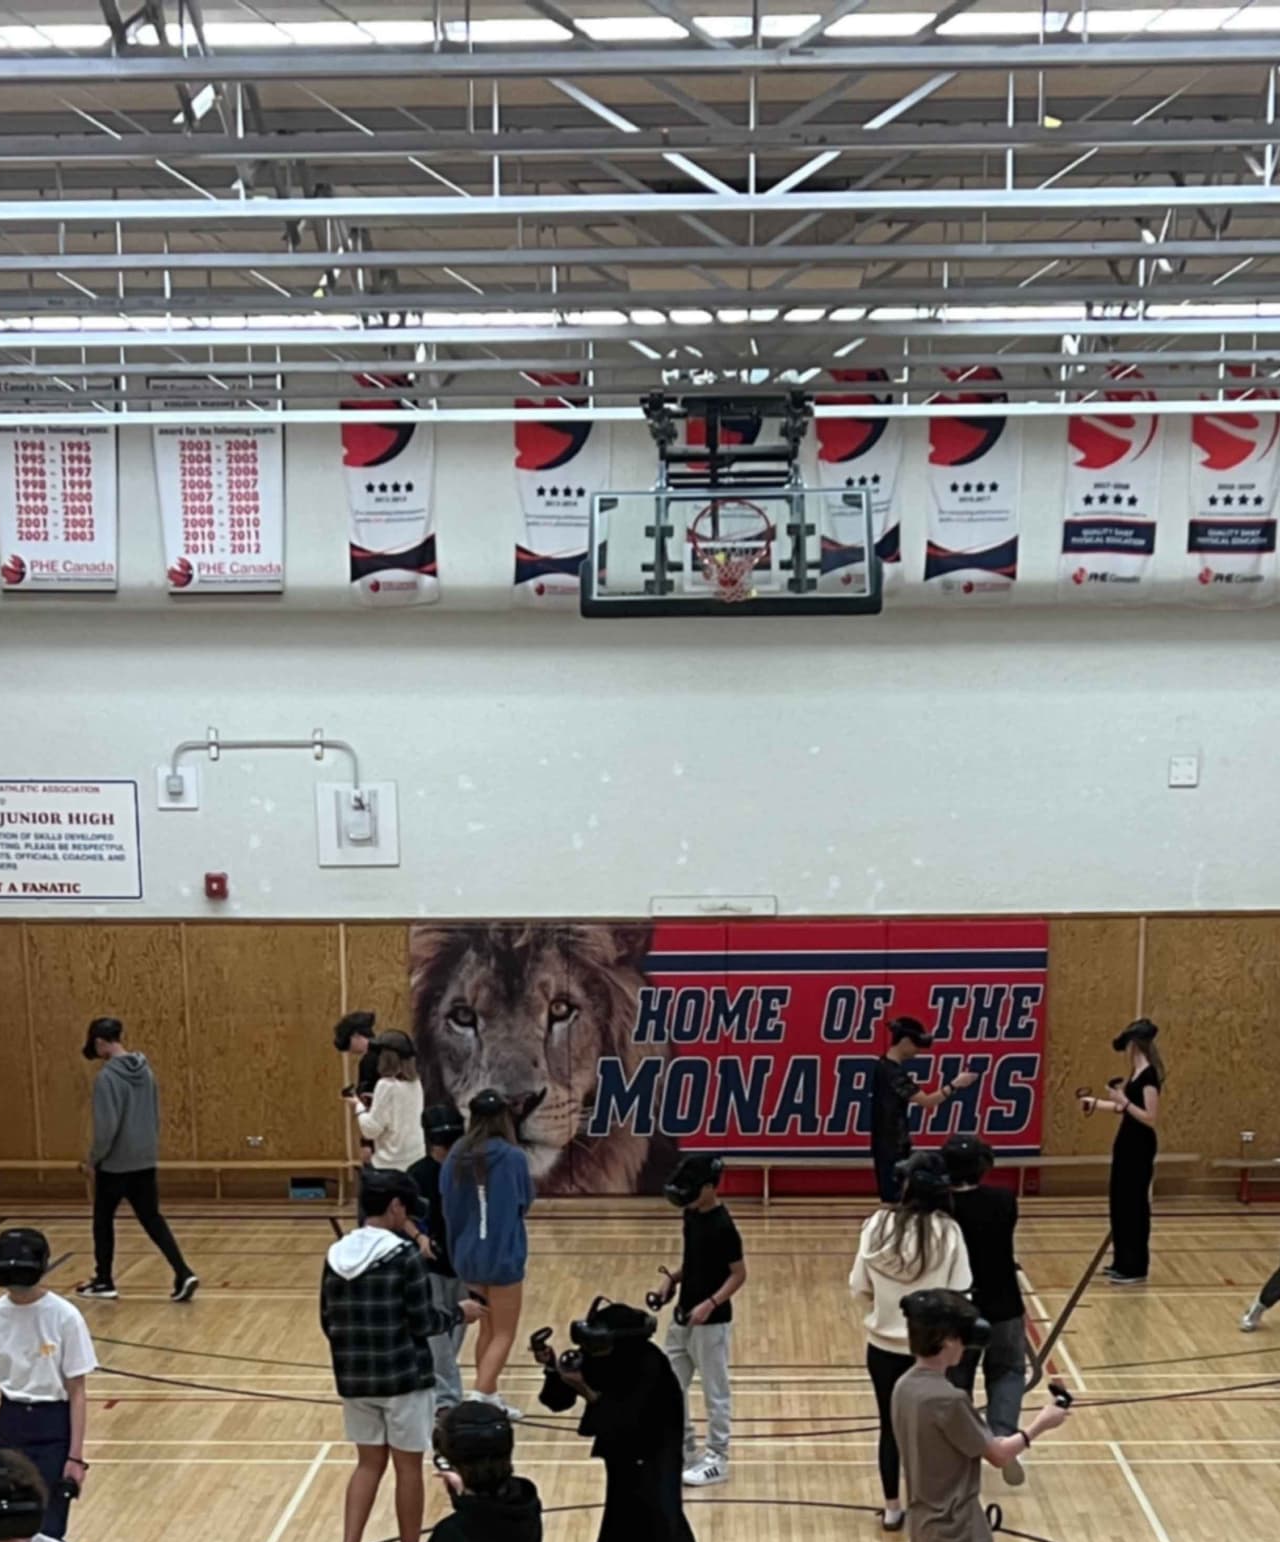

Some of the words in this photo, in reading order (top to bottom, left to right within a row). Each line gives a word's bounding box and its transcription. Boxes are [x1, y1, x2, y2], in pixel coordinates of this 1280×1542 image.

[14, 441, 45, 451] 1994
[61, 441, 91, 451] 1995
[179, 441, 211, 451] 2003
[225, 441, 257, 451] 2004
[15, 454, 45, 464] 1995
[61, 454, 91, 464] 1996
[180, 454, 211, 464] 2004
[226, 454, 258, 464] 2005
[15, 467, 46, 477] 1996
[62, 467, 91, 477] 1997
[181, 467, 212, 477] 2005
[227, 467, 258, 477] 2006
[15, 479, 46, 490] 1998
[62, 479, 92, 490] 1999
[181, 479, 212, 490] 2006
[227, 479, 258, 490] 2007
[16, 492, 47, 502] 1999
[62, 492, 92, 502] 2000
[181, 492, 213, 502] 2007
[228, 492, 259, 502] 2008
[16, 505, 48, 515] 2000
[63, 505, 92, 515] 2001
[182, 505, 213, 515] 2008
[228, 505, 259, 515] 2009
[17, 518, 47, 528] 2001
[63, 518, 94, 528] 2002
[183, 518, 214, 528] 2009
[229, 518, 260, 528] 2010
[17, 531, 48, 541] 2002
[64, 531, 94, 541] 2003
[184, 530, 215, 541] 2010
[230, 530, 259, 541] 2011
[184, 543, 214, 554] 2011
[230, 543, 261, 554] 2012
[30, 560, 58, 572] PHE
[62, 560, 114, 572] Canada
[198, 562, 226, 574] PHE
[229, 562, 281, 574] Canada
[0, 785, 39, 793] ATHLETIC
[68, 813, 115, 825] HIGH
[34, 833, 62, 841] SKILLS
[8, 883, 18, 893] A
[21, 882, 81, 893] FANATIC
[631, 986, 791, 1043] HOME
[821, 985, 896, 1043] OF
[928, 984, 1044, 1042] THE
